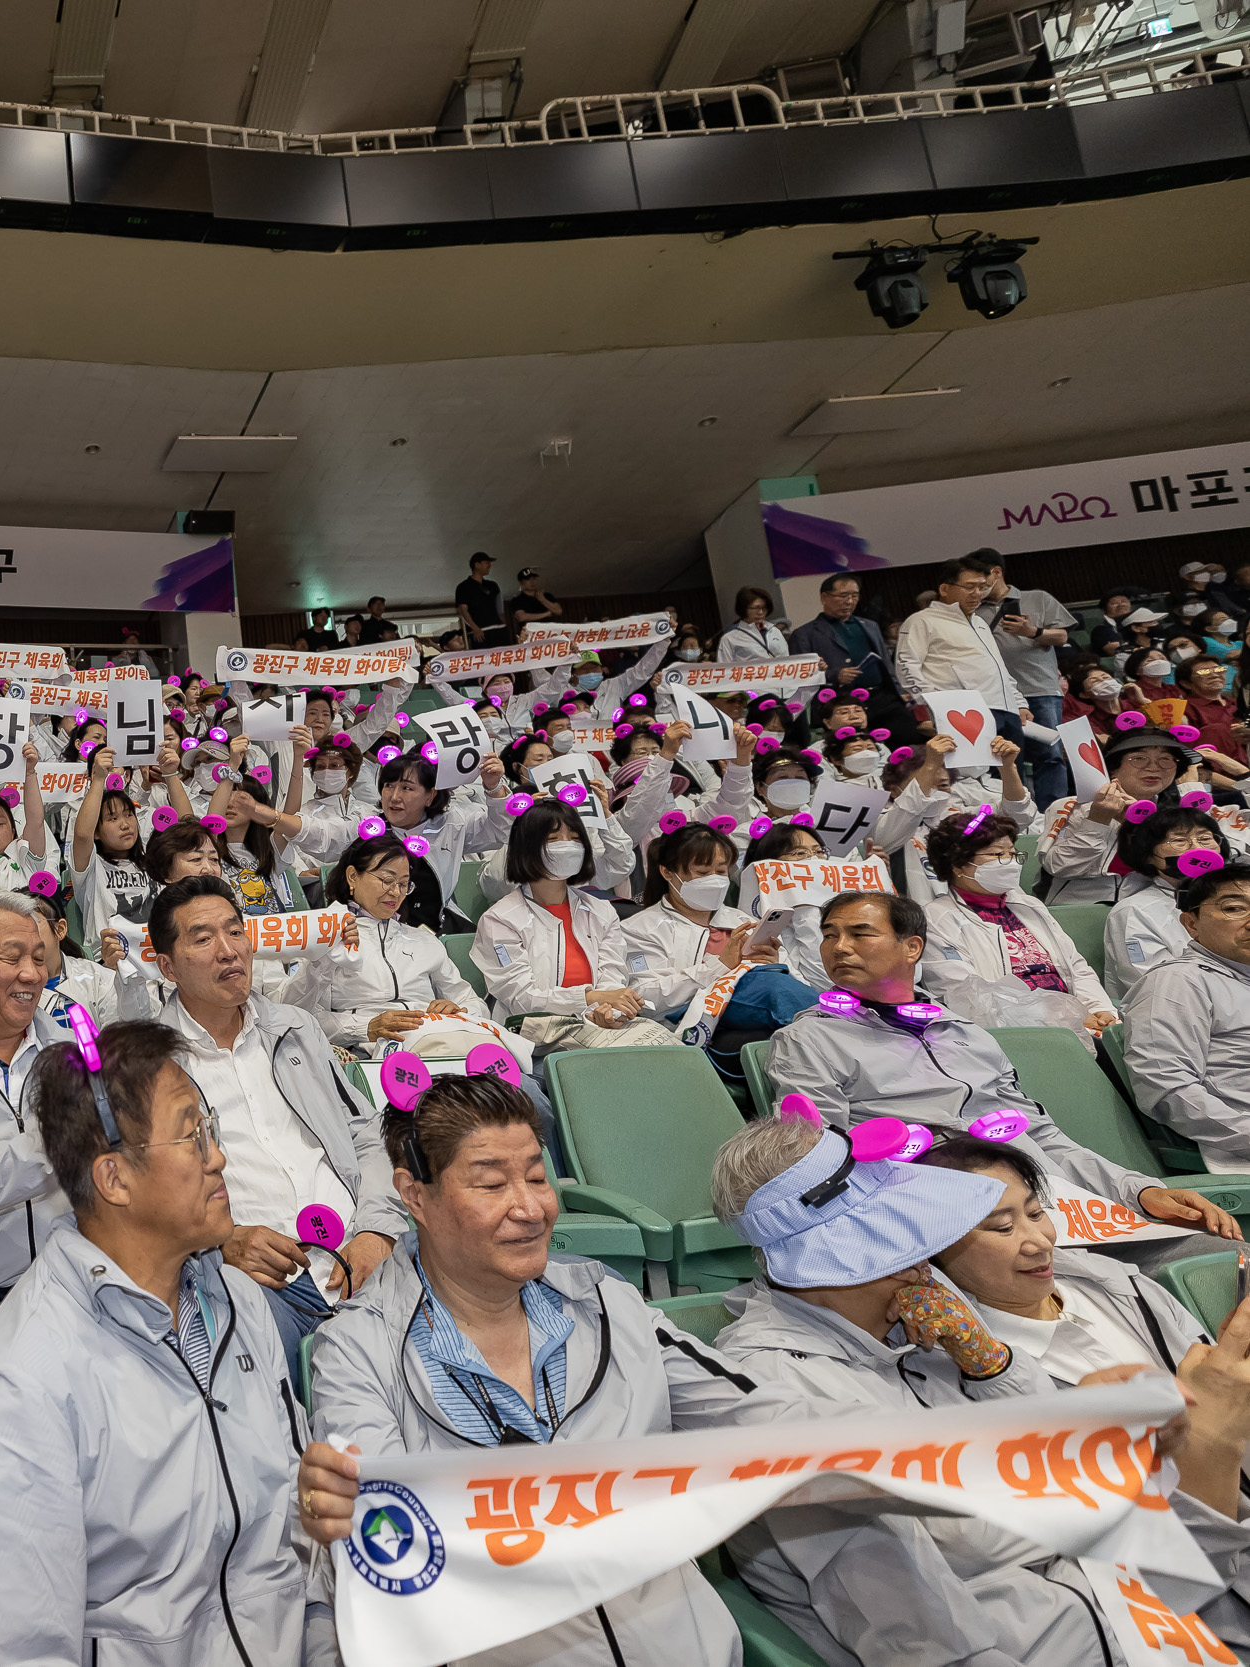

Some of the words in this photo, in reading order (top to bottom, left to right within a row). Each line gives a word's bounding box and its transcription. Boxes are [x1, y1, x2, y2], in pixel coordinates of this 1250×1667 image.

[24, 651, 64, 670] 체육회
[252, 653, 300, 674] 광진구
[303, 656, 350, 676] 체육회
[354, 656, 407, 675] 화이팅!
[448, 657, 485, 675] 광진구
[489, 648, 527, 667] 체육회
[686, 667, 726, 686] 광진구
[729, 664, 770, 683] 체육회
[771, 662, 817, 681] 화이팅!
[30, 685, 71, 707] 광진구
[116, 698, 156, 756] 님
[430, 716, 482, 775] 랑
[815, 802, 871, 845] 다
[1188, 857, 1212, 870] 광진
[820, 863, 884, 892] 체육회
[395, 1066, 419, 1088] 광진
[485, 1057, 510, 1076] 광진
[988, 1124, 1019, 1139] 광진
[310, 1215, 329, 1240] 광진
